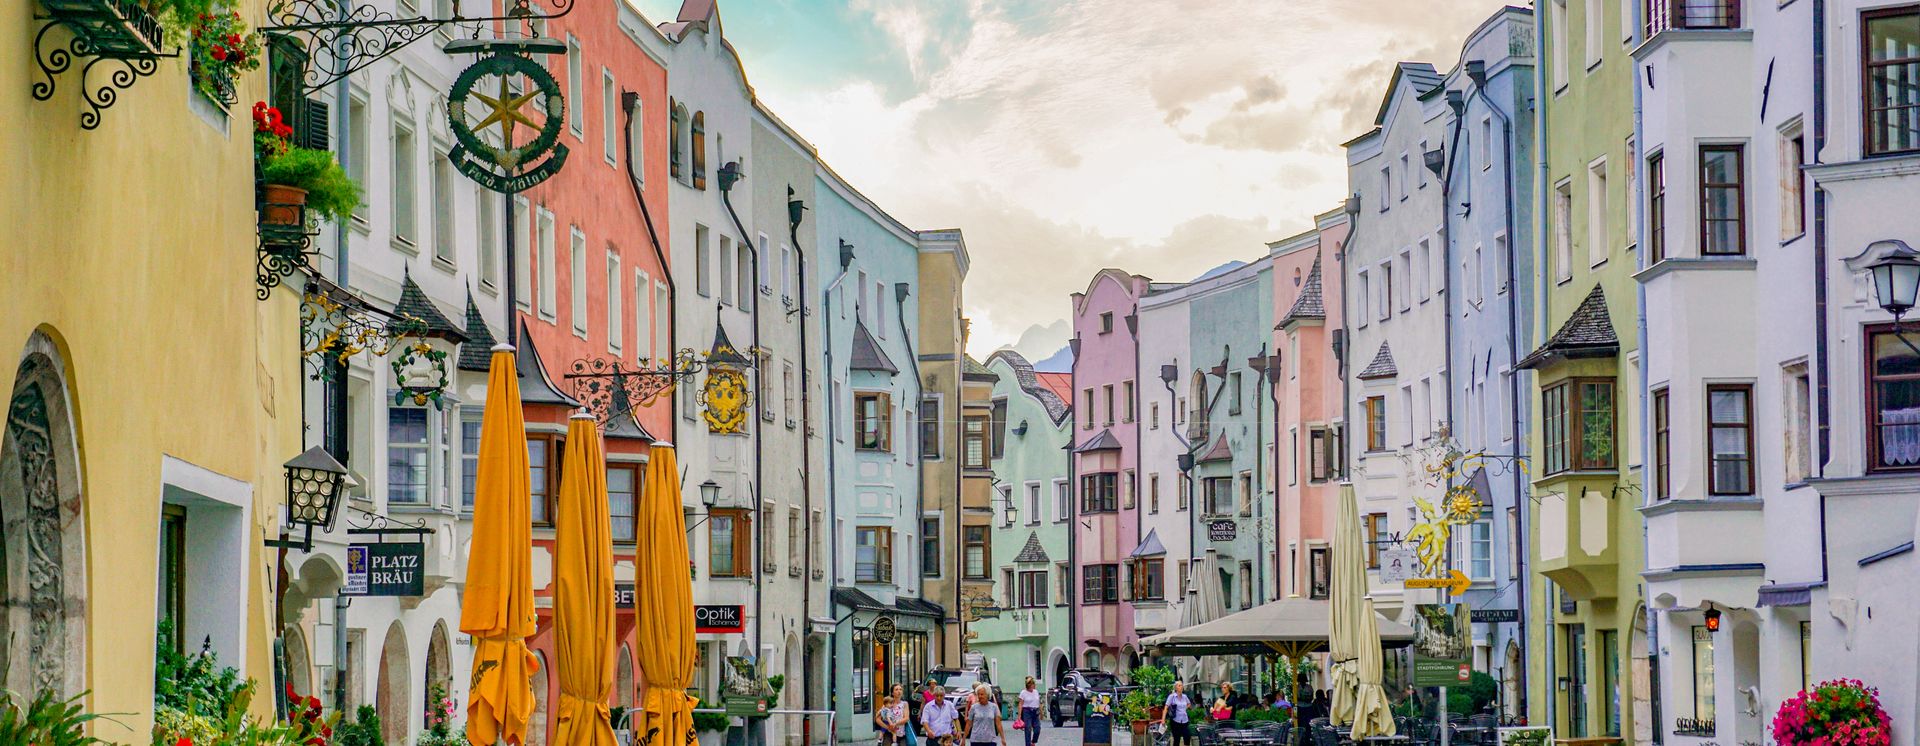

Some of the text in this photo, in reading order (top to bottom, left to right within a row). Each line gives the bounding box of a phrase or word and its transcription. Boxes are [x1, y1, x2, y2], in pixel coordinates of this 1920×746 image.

[371, 555, 418, 568] PLATZ
[371, 569, 414, 585] BRÄU
[695, 607, 735, 626] Optik
